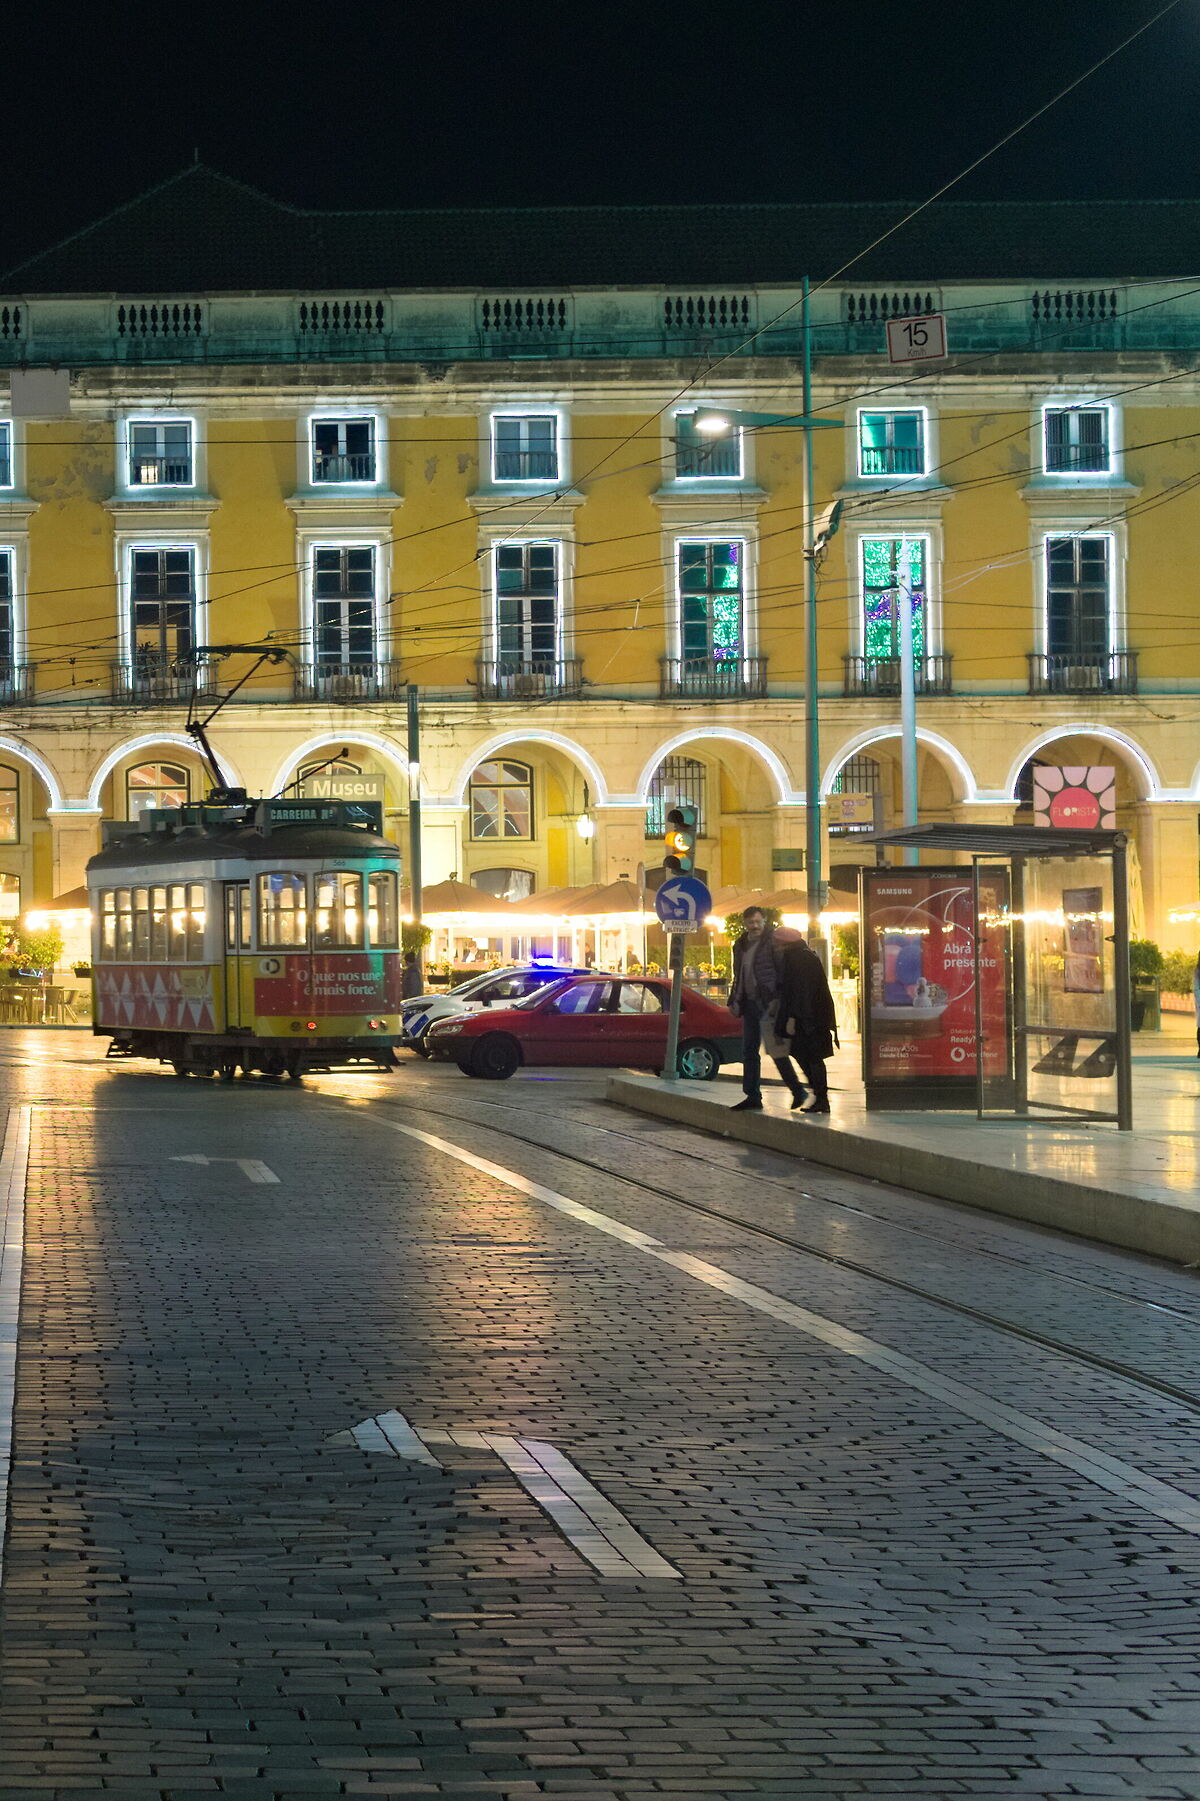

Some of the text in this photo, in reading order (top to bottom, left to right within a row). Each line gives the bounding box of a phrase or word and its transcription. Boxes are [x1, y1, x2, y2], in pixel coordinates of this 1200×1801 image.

[903, 322, 928, 347] 15
[312, 780, 377, 796] Museu
[270, 809, 317, 820] CARREIRA
[1053, 807, 1097, 817] FLORISTA
[944, 944, 972, 954] Abra
[944, 957, 996, 970] presente
[296, 970, 381, 984] O que nos une
[303, 984, 311, 996] é
[312, 983, 345, 996] mais
